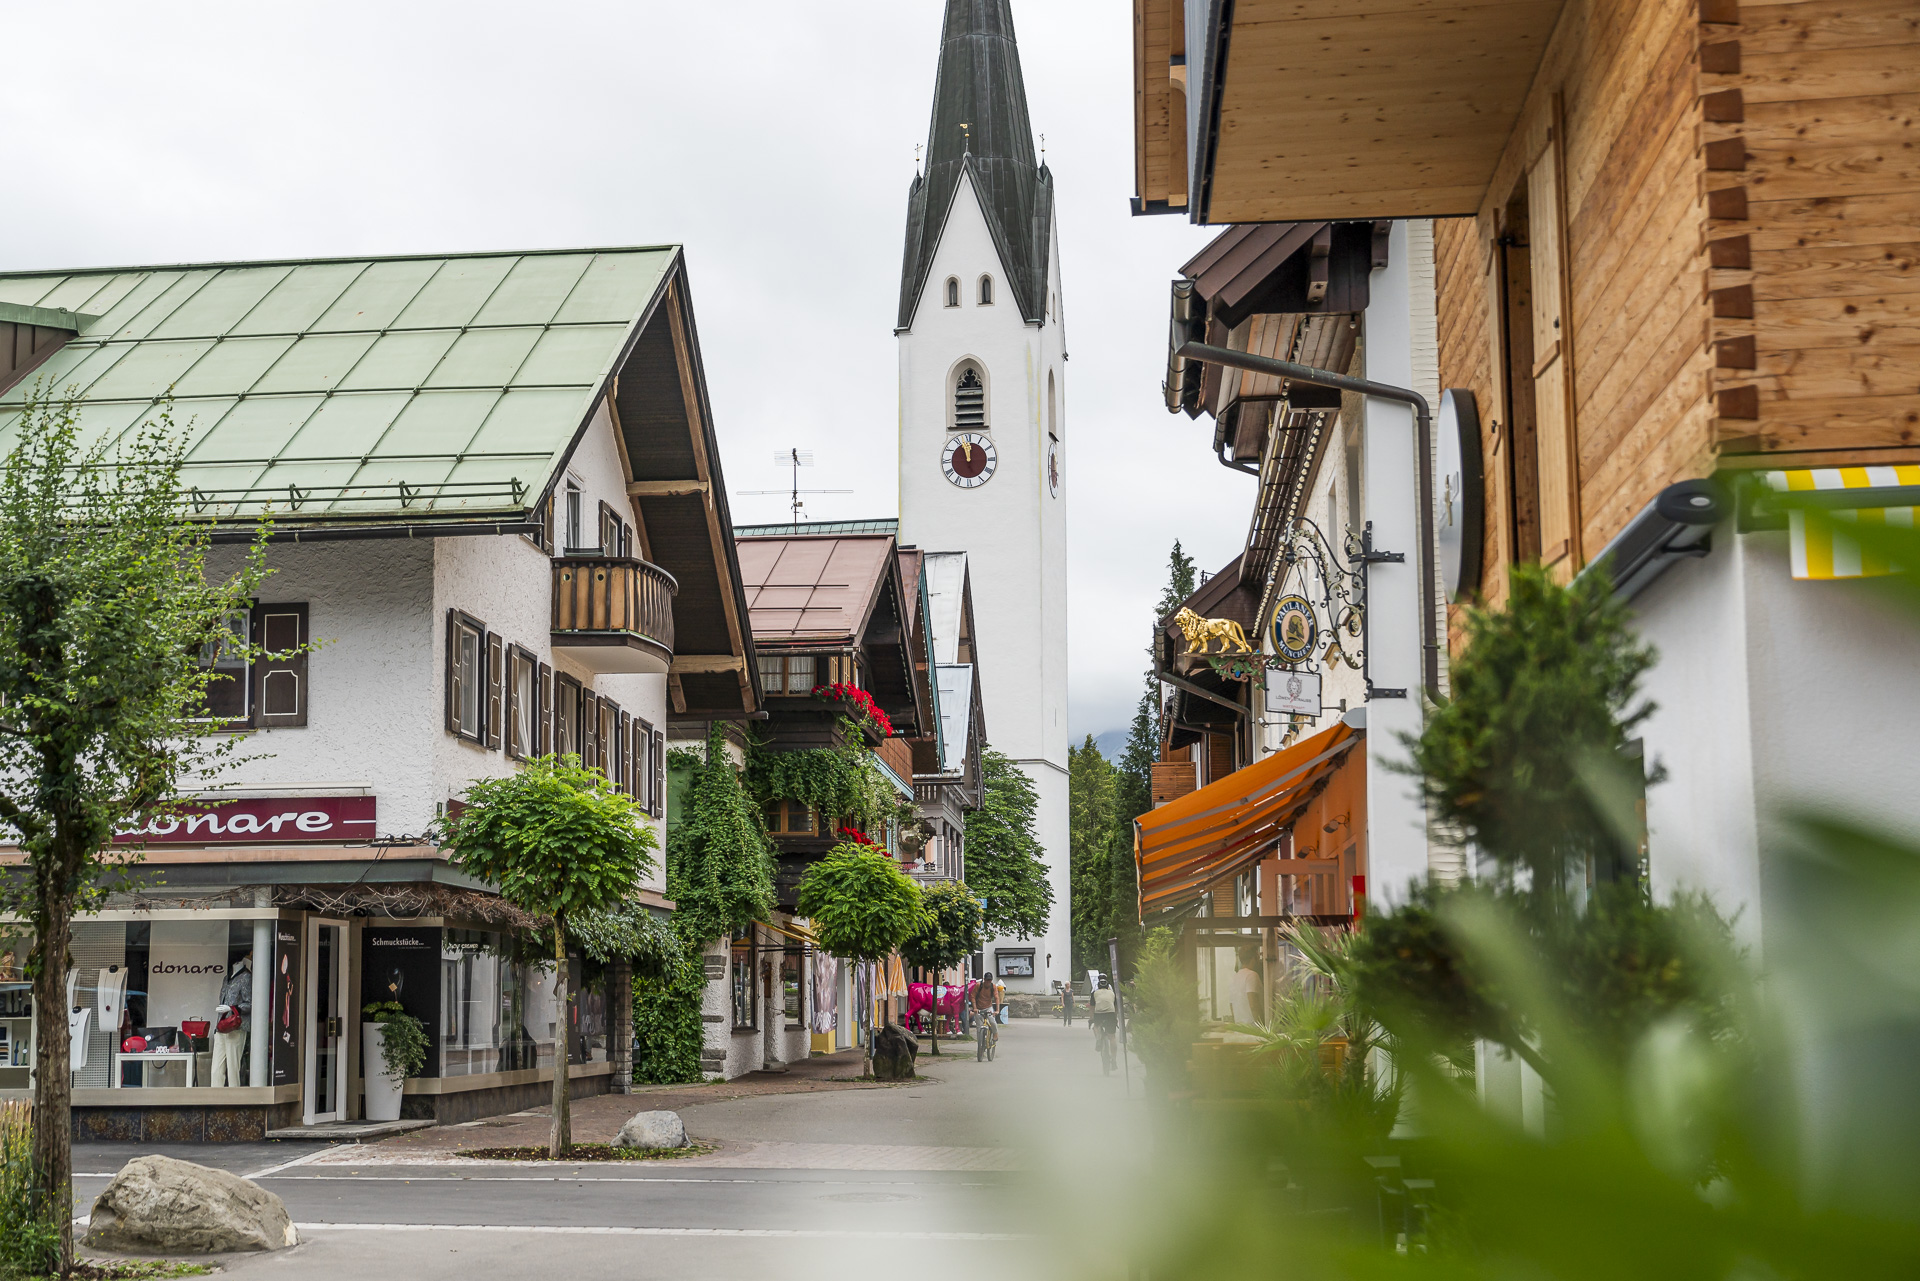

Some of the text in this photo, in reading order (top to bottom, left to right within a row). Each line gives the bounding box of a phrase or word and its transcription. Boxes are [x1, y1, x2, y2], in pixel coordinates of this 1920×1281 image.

[1276, 601, 1314, 627] PAULANER
[1278, 640, 1311, 658] MÜNCHEN
[152, 961, 224, 974] donare
